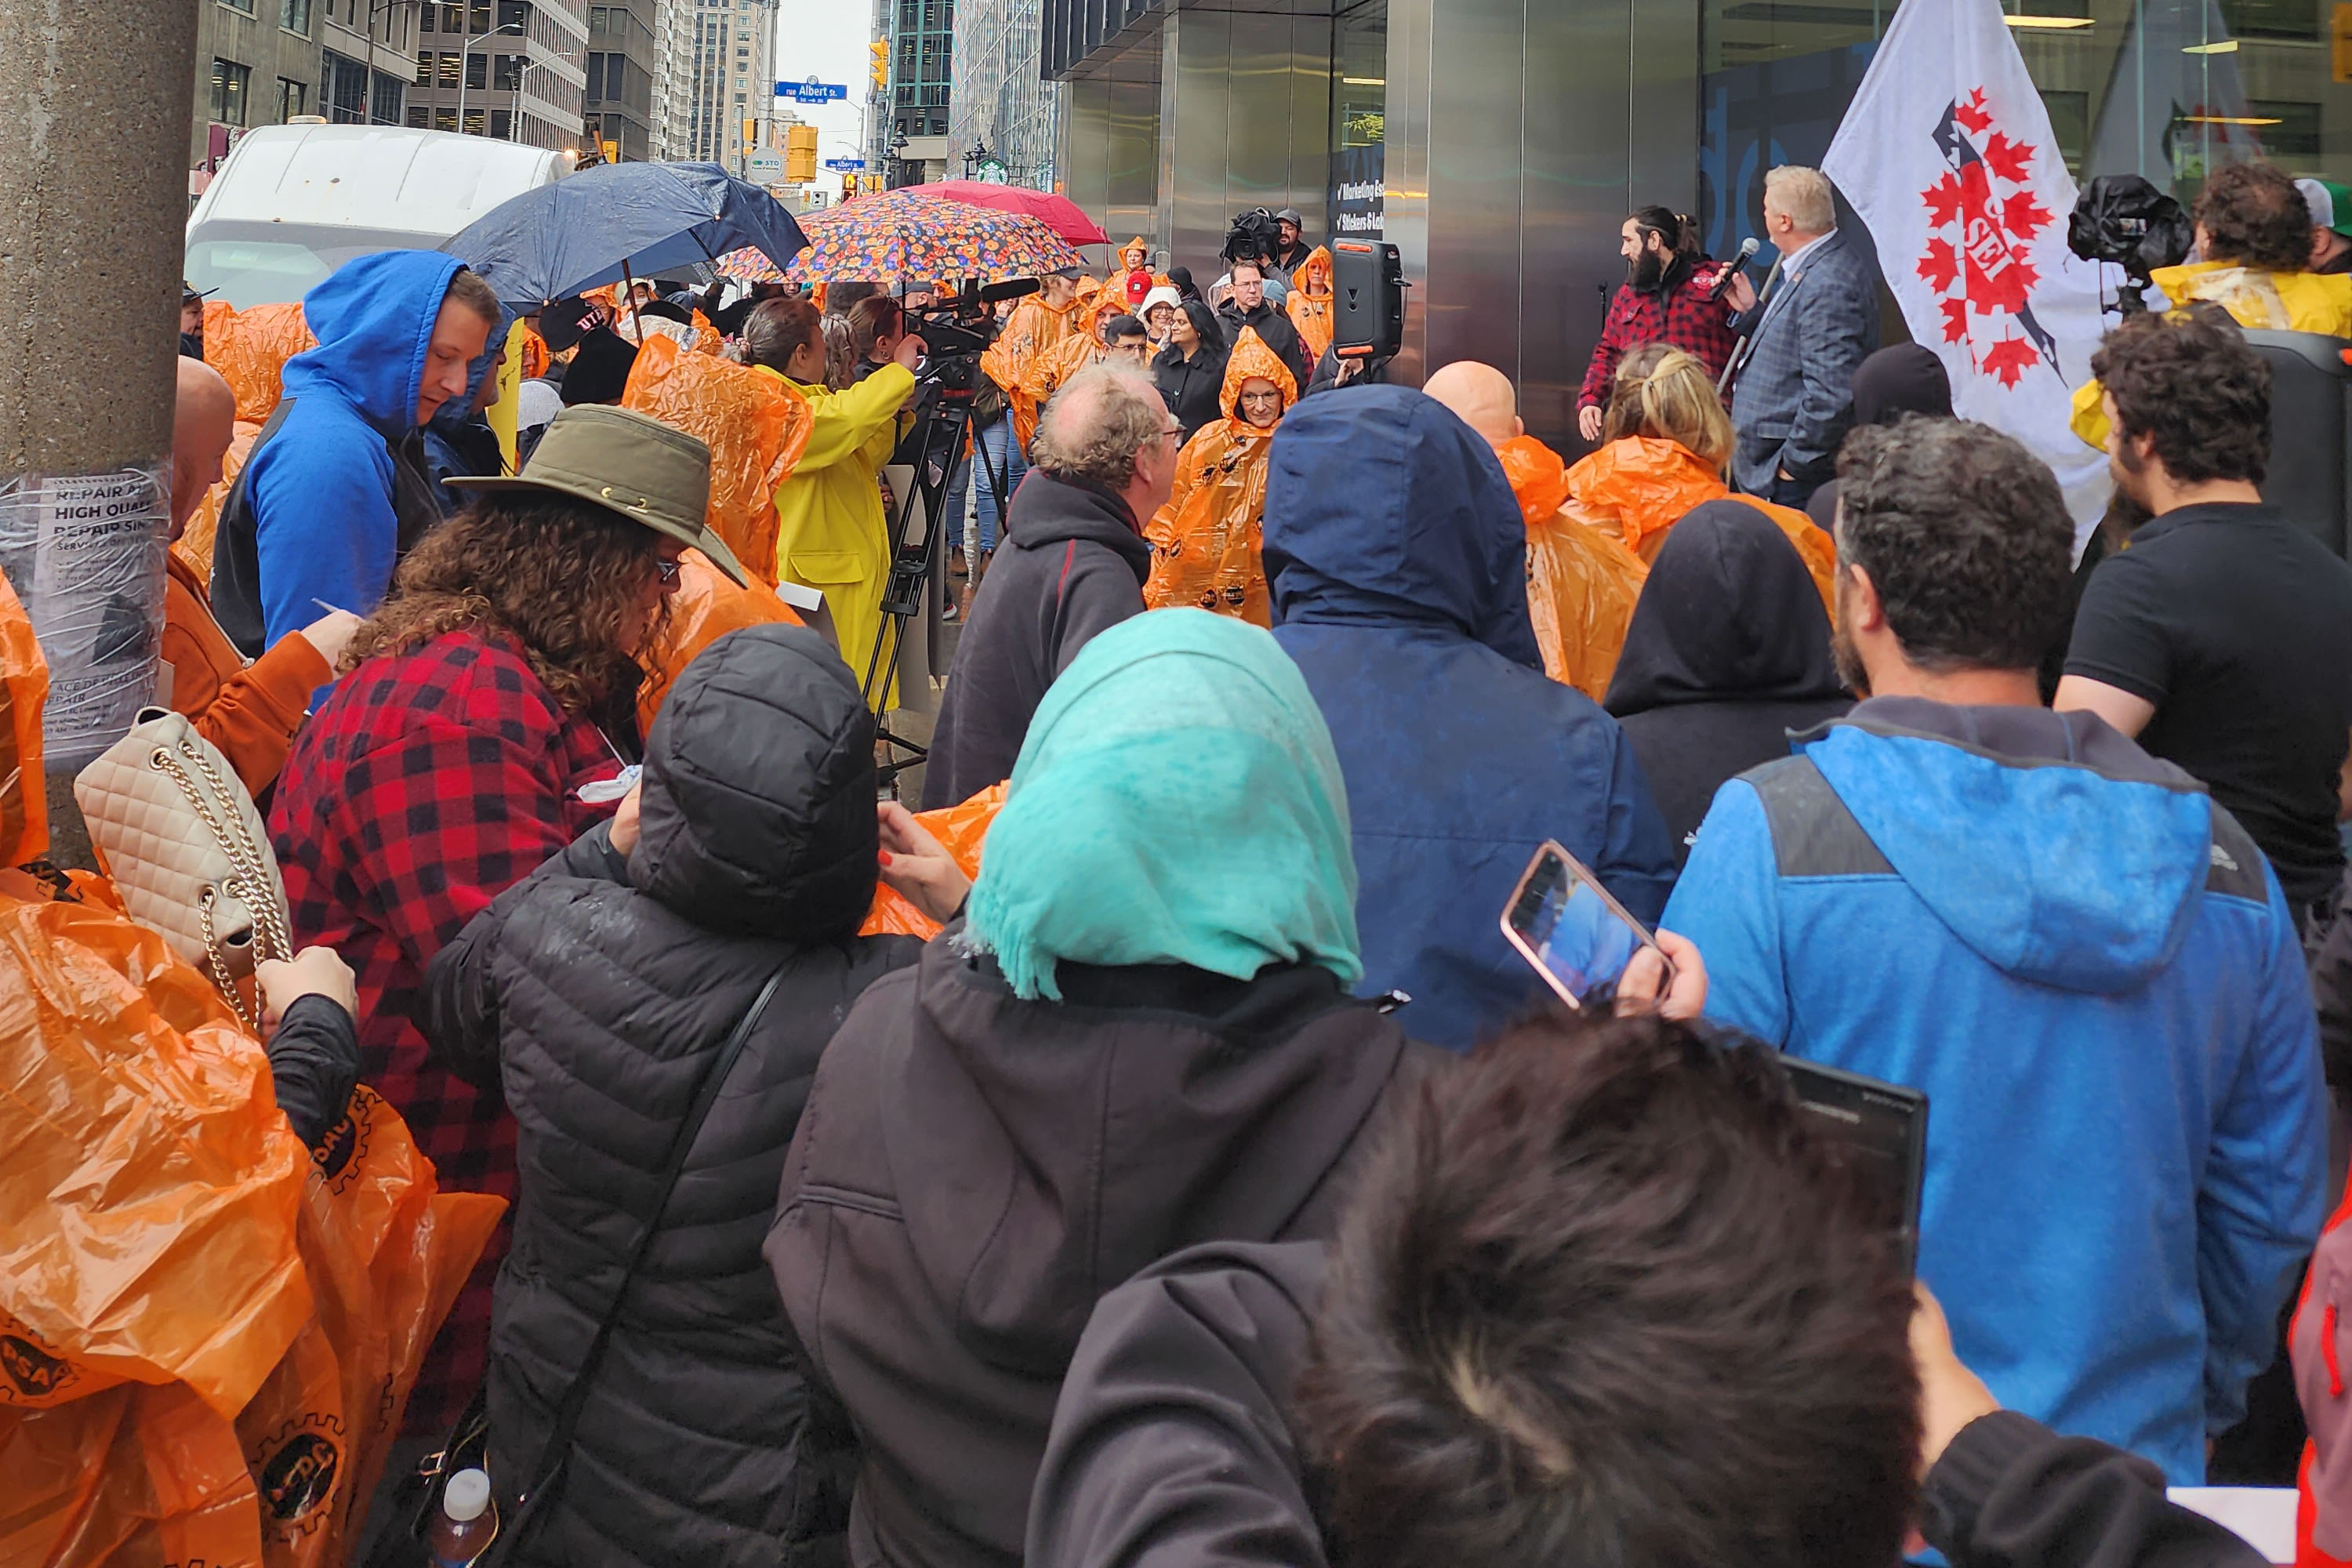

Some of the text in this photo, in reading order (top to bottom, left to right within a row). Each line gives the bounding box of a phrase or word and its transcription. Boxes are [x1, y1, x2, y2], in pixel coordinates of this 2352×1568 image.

[799, 85, 827, 96] Albert
[1343, 180, 1374, 202] Marketing
[1342, 212, 1367, 231] Stickers
[1963, 216, 2016, 282] SEI
[55, 505, 101, 519] HIGH
